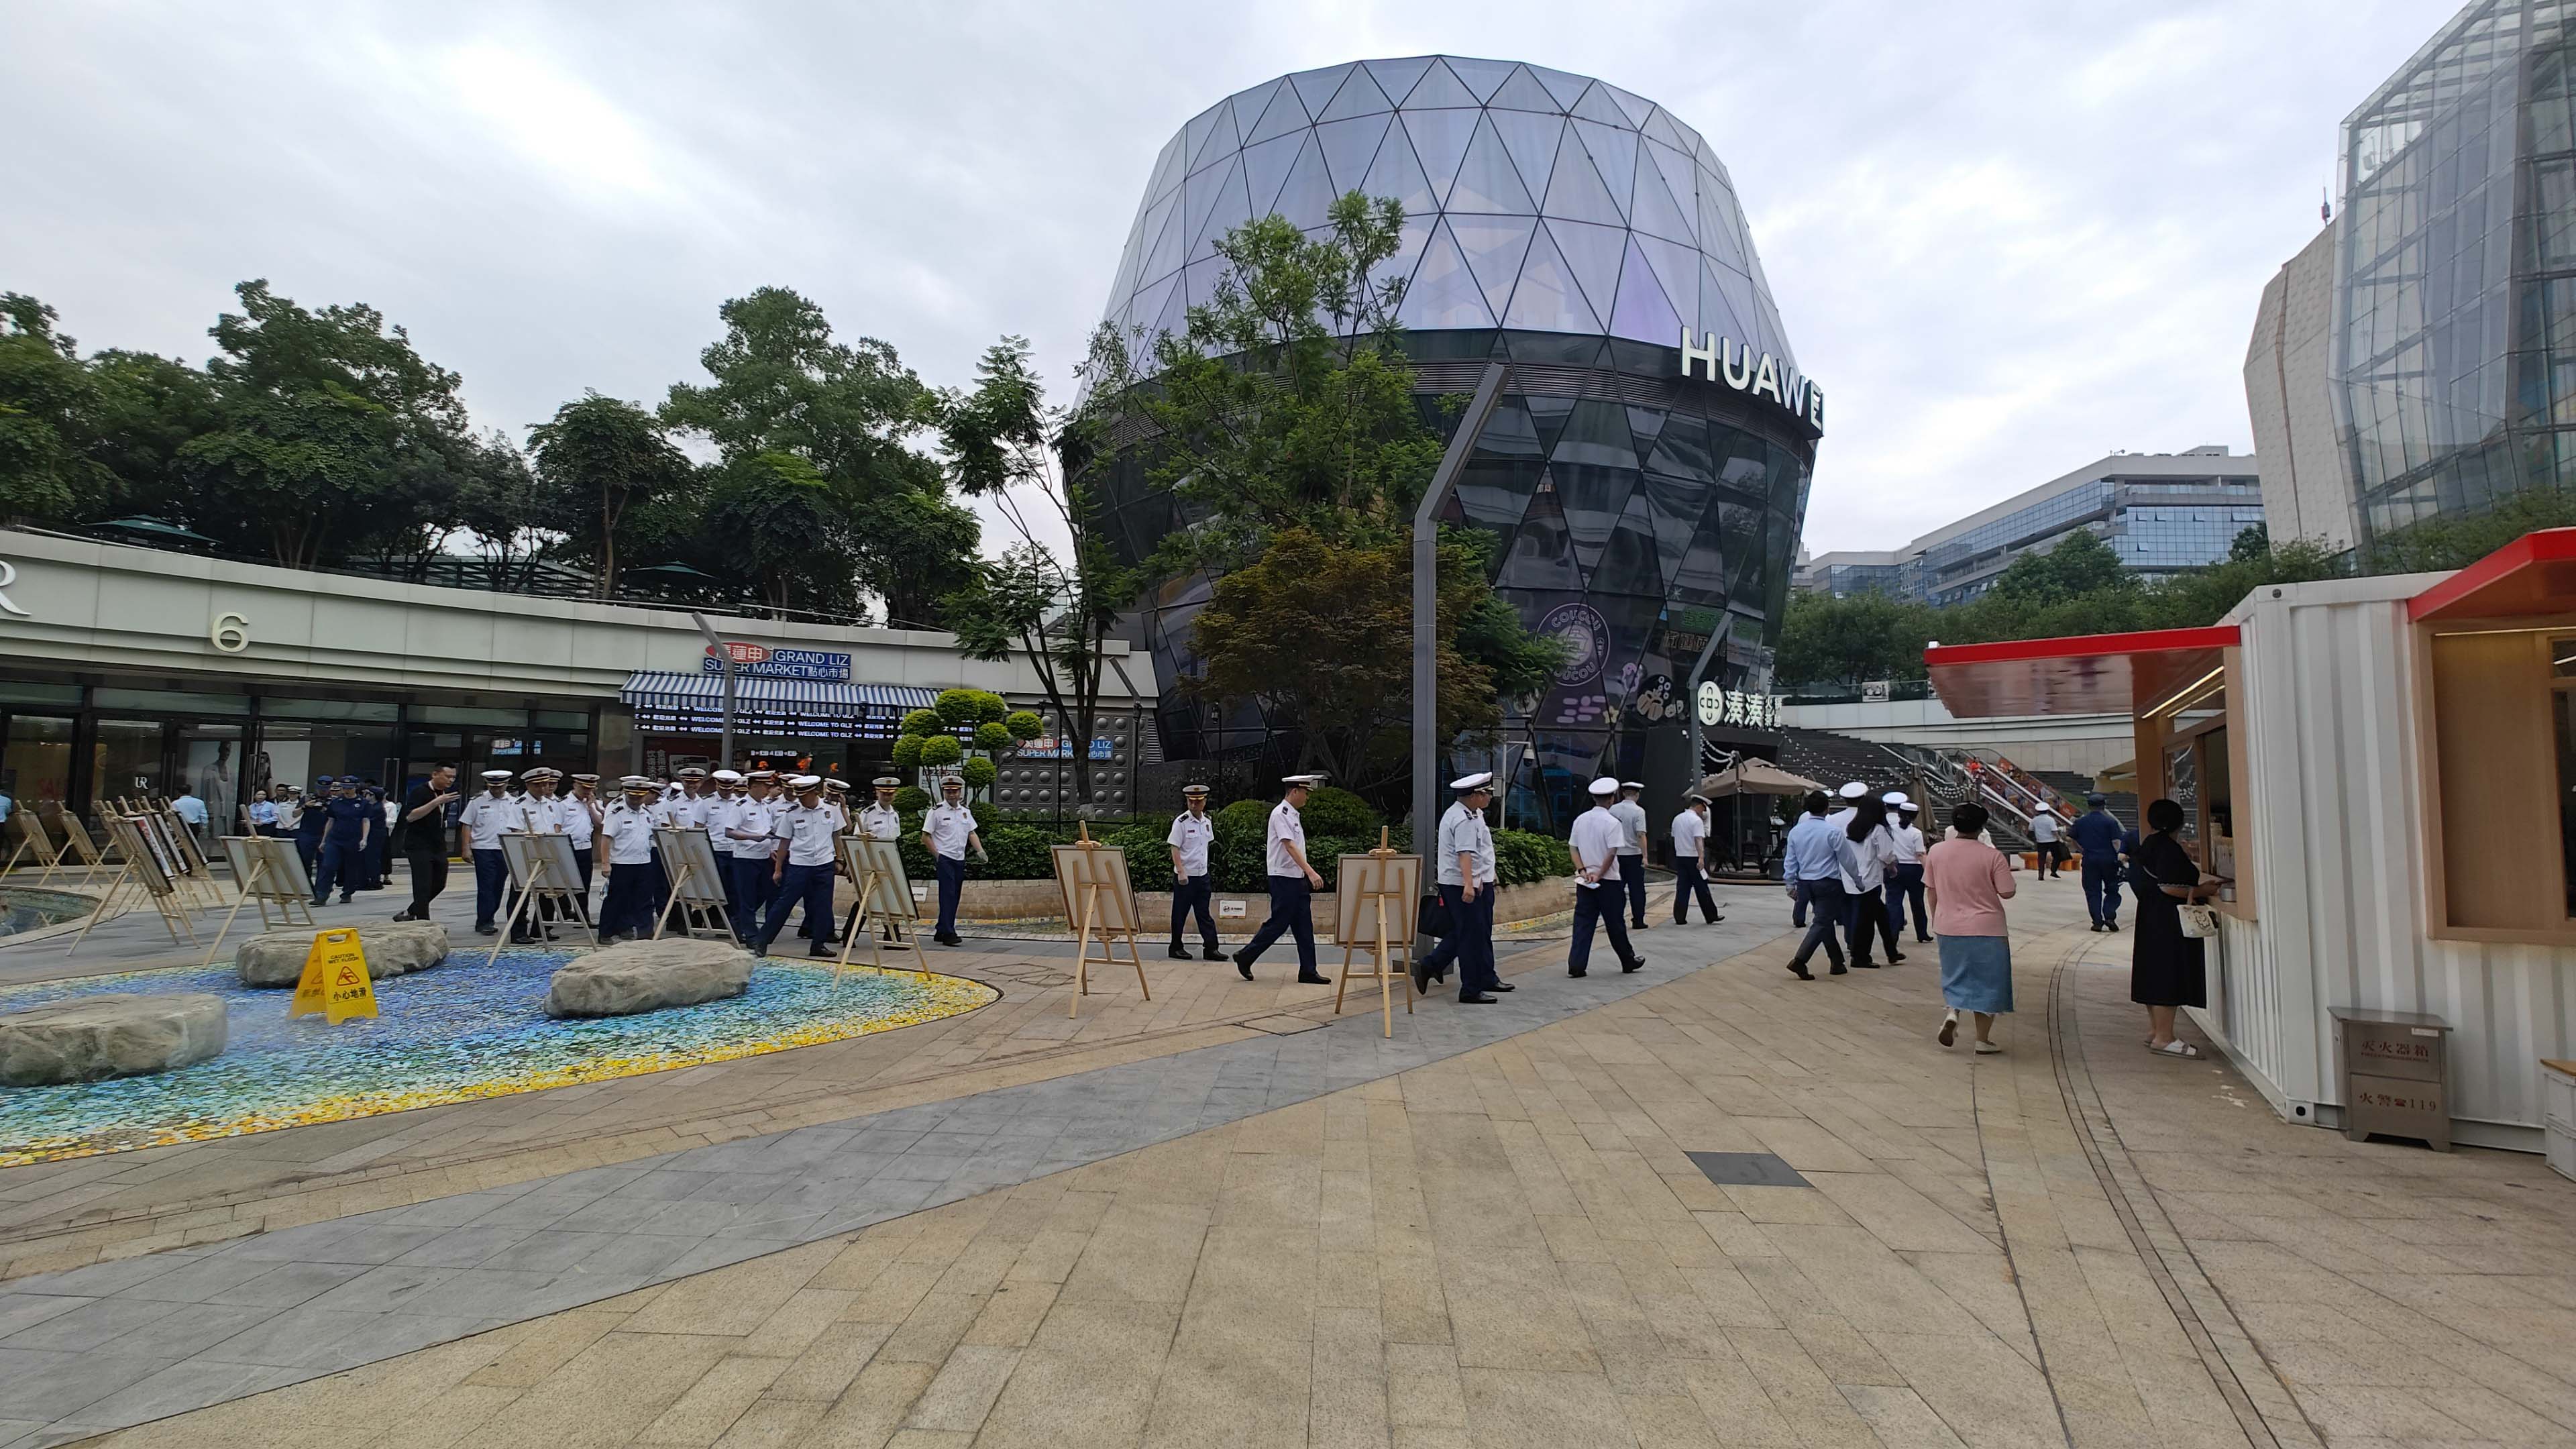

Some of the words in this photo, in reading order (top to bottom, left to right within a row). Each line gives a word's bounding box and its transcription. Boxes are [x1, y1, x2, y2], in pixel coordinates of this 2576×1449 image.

[1551, 609, 1602, 631] COUCOU
[211, 611, 250, 653] 6
[716, 645, 763, 662] 蓮申
[775, 651, 825, 664] GRAND
[829, 655, 849, 666] LIZ
[705, 660, 749, 673] SUER
[753, 663, 806, 677] MARKET
[1097, 741, 1112, 749] LIZ
[1017, 749, 1046, 757] SUPER
[135, 776, 149, 790] UR
[333, 987, 367, 1002] 小心地滑
[2362, 1040, 2429, 1057] 灭火器箱
[2410, 1098, 2436, 1112] 119
